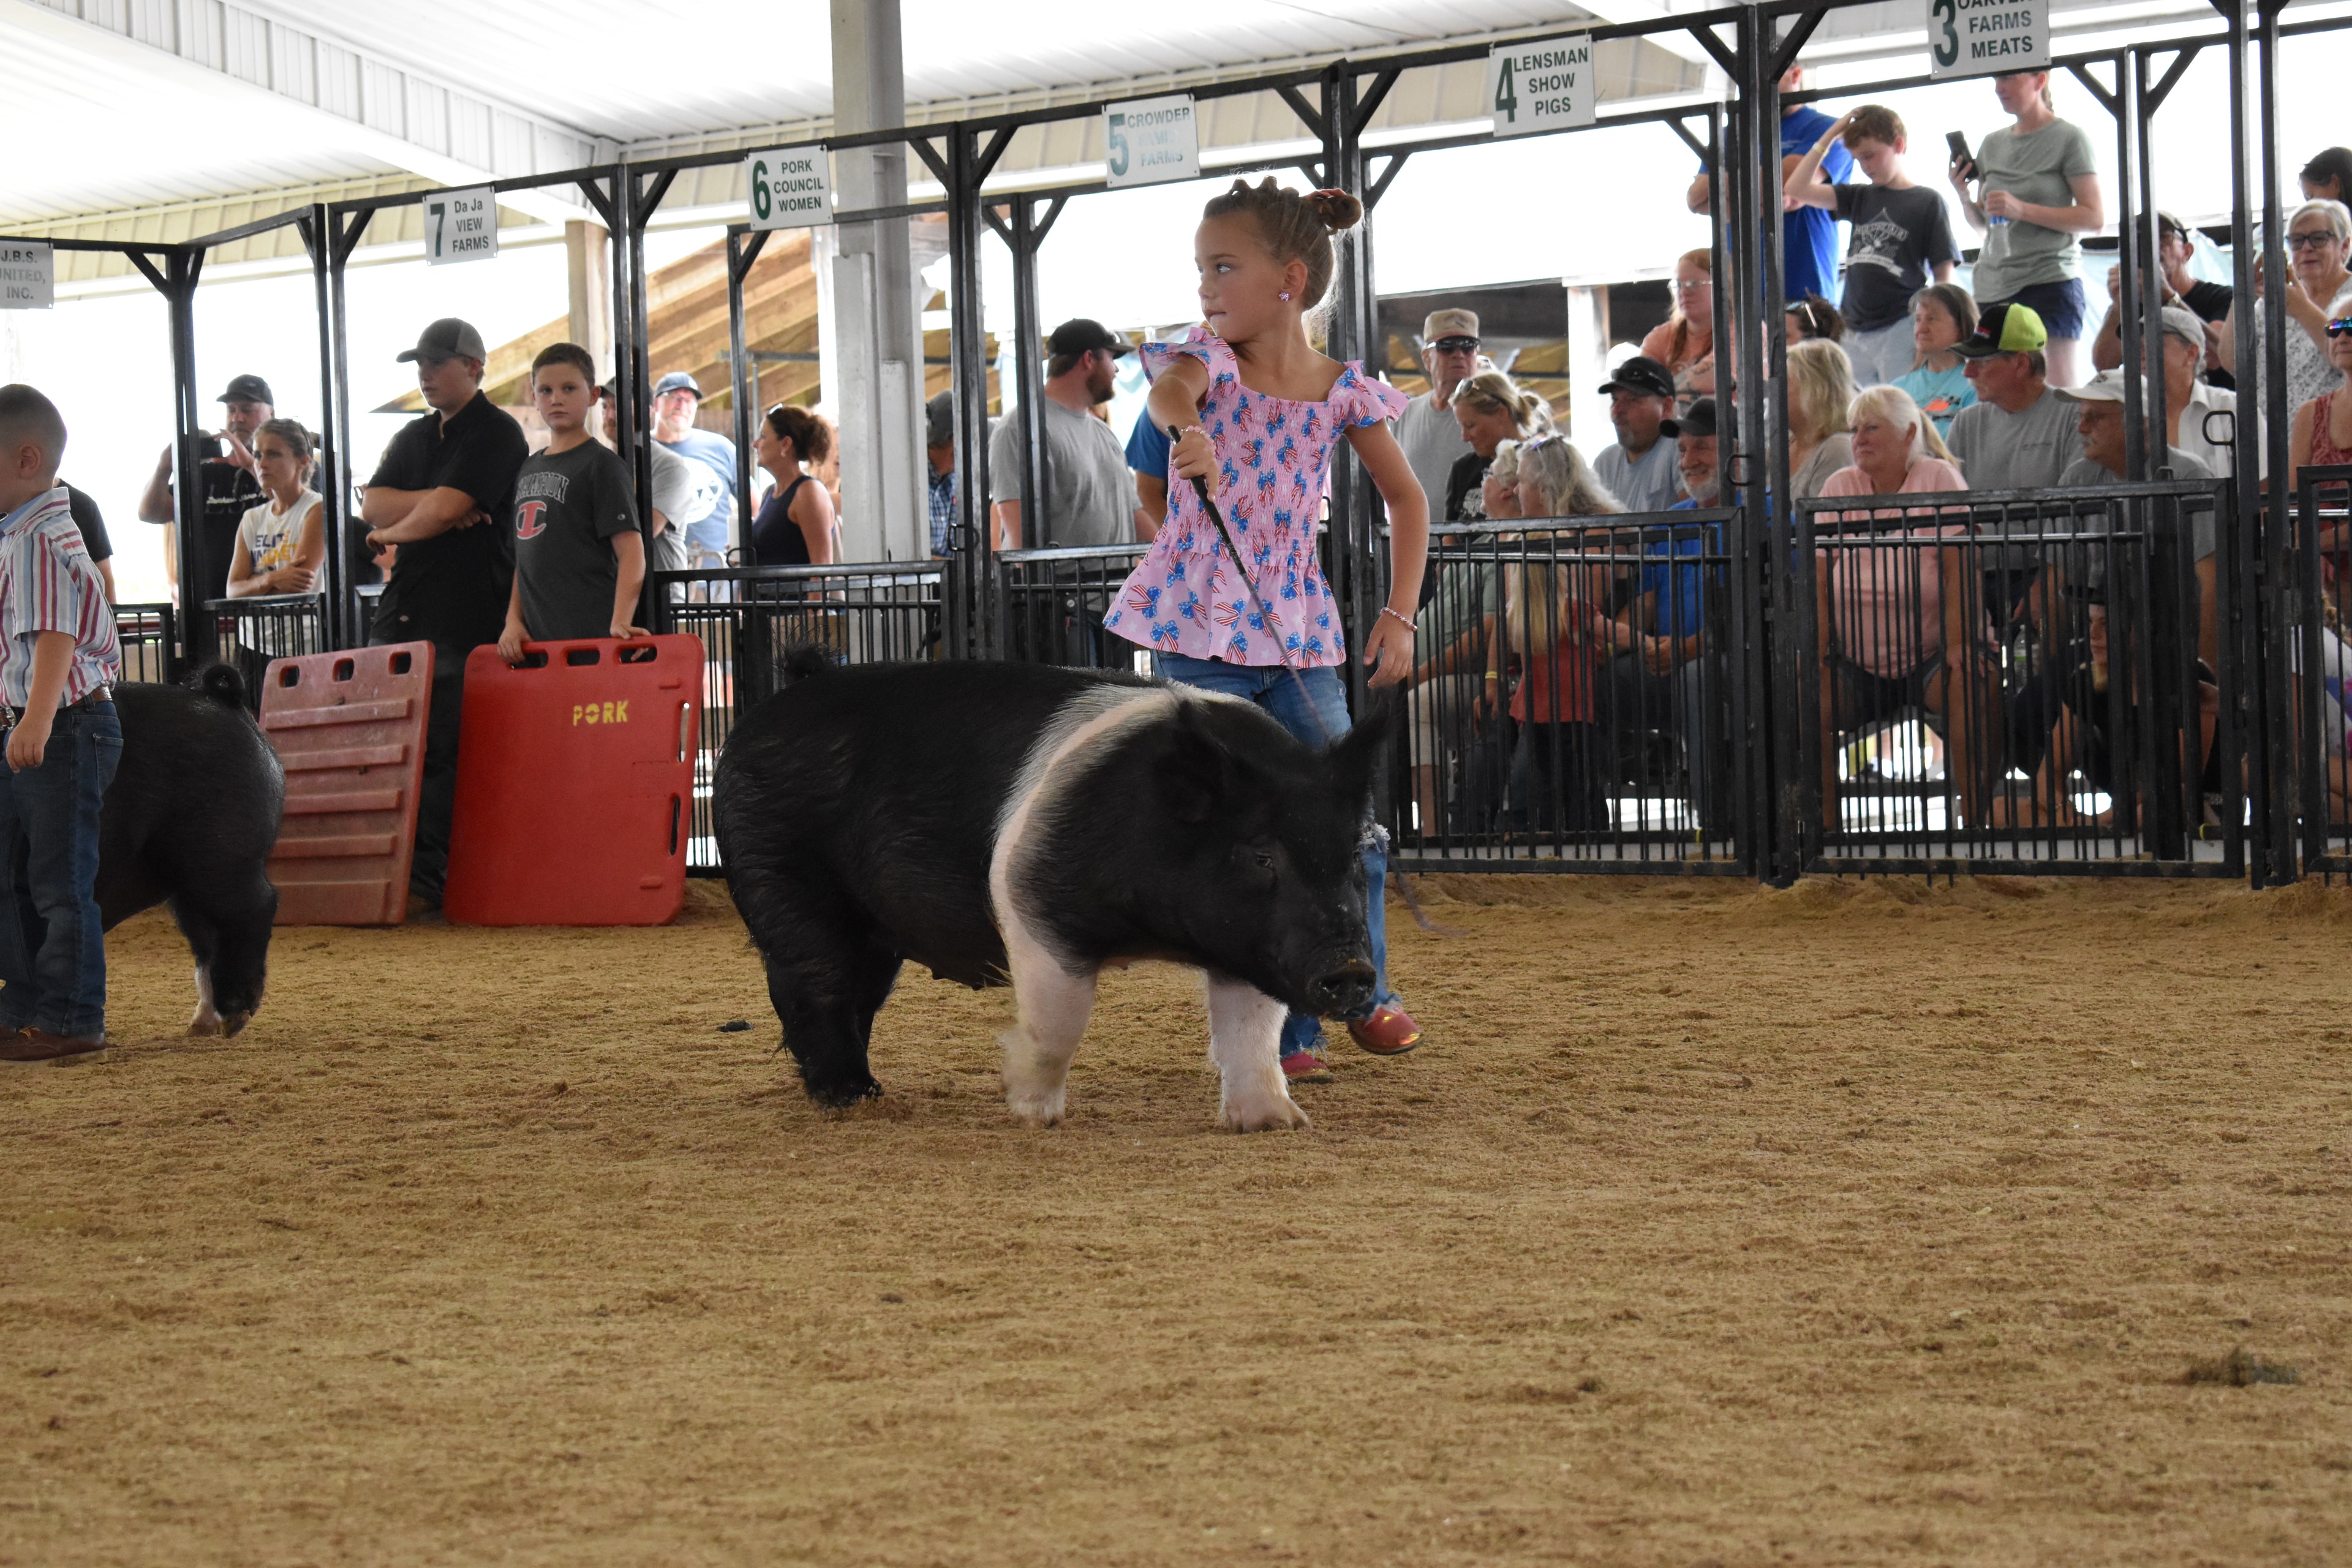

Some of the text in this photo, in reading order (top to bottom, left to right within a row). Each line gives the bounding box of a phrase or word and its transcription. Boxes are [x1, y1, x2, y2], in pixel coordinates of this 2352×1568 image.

[1969, 10, 2032, 34] FARMS
[1932, 0, 1959, 67] 3
[1971, 36, 2033, 59] MEATS
[1513, 47, 1588, 72] LENSMAN
[1495, 58, 1517, 123] 4
[1529, 72, 1575, 94] SHOW
[1535, 97, 1571, 116] PIGS
[1128, 107, 1191, 128] CROWDER
[1109, 113, 1129, 176] 5
[782, 159, 812, 174] PORK
[752, 160, 771, 221] 6
[774, 177, 824, 194] COUNCIL
[454, 198, 483, 213] Da Ja
[778, 196, 821, 212] WOMEN
[430, 202, 445, 257] 7
[456, 217, 483, 232] VIEW
[452, 236, 489, 253] FARMS
[1, 249, 37, 263] J.B.S.
[0, 268, 45, 284] NITED,
[7, 286, 34, 299] INC.
[573, 700, 628, 726] PORK
